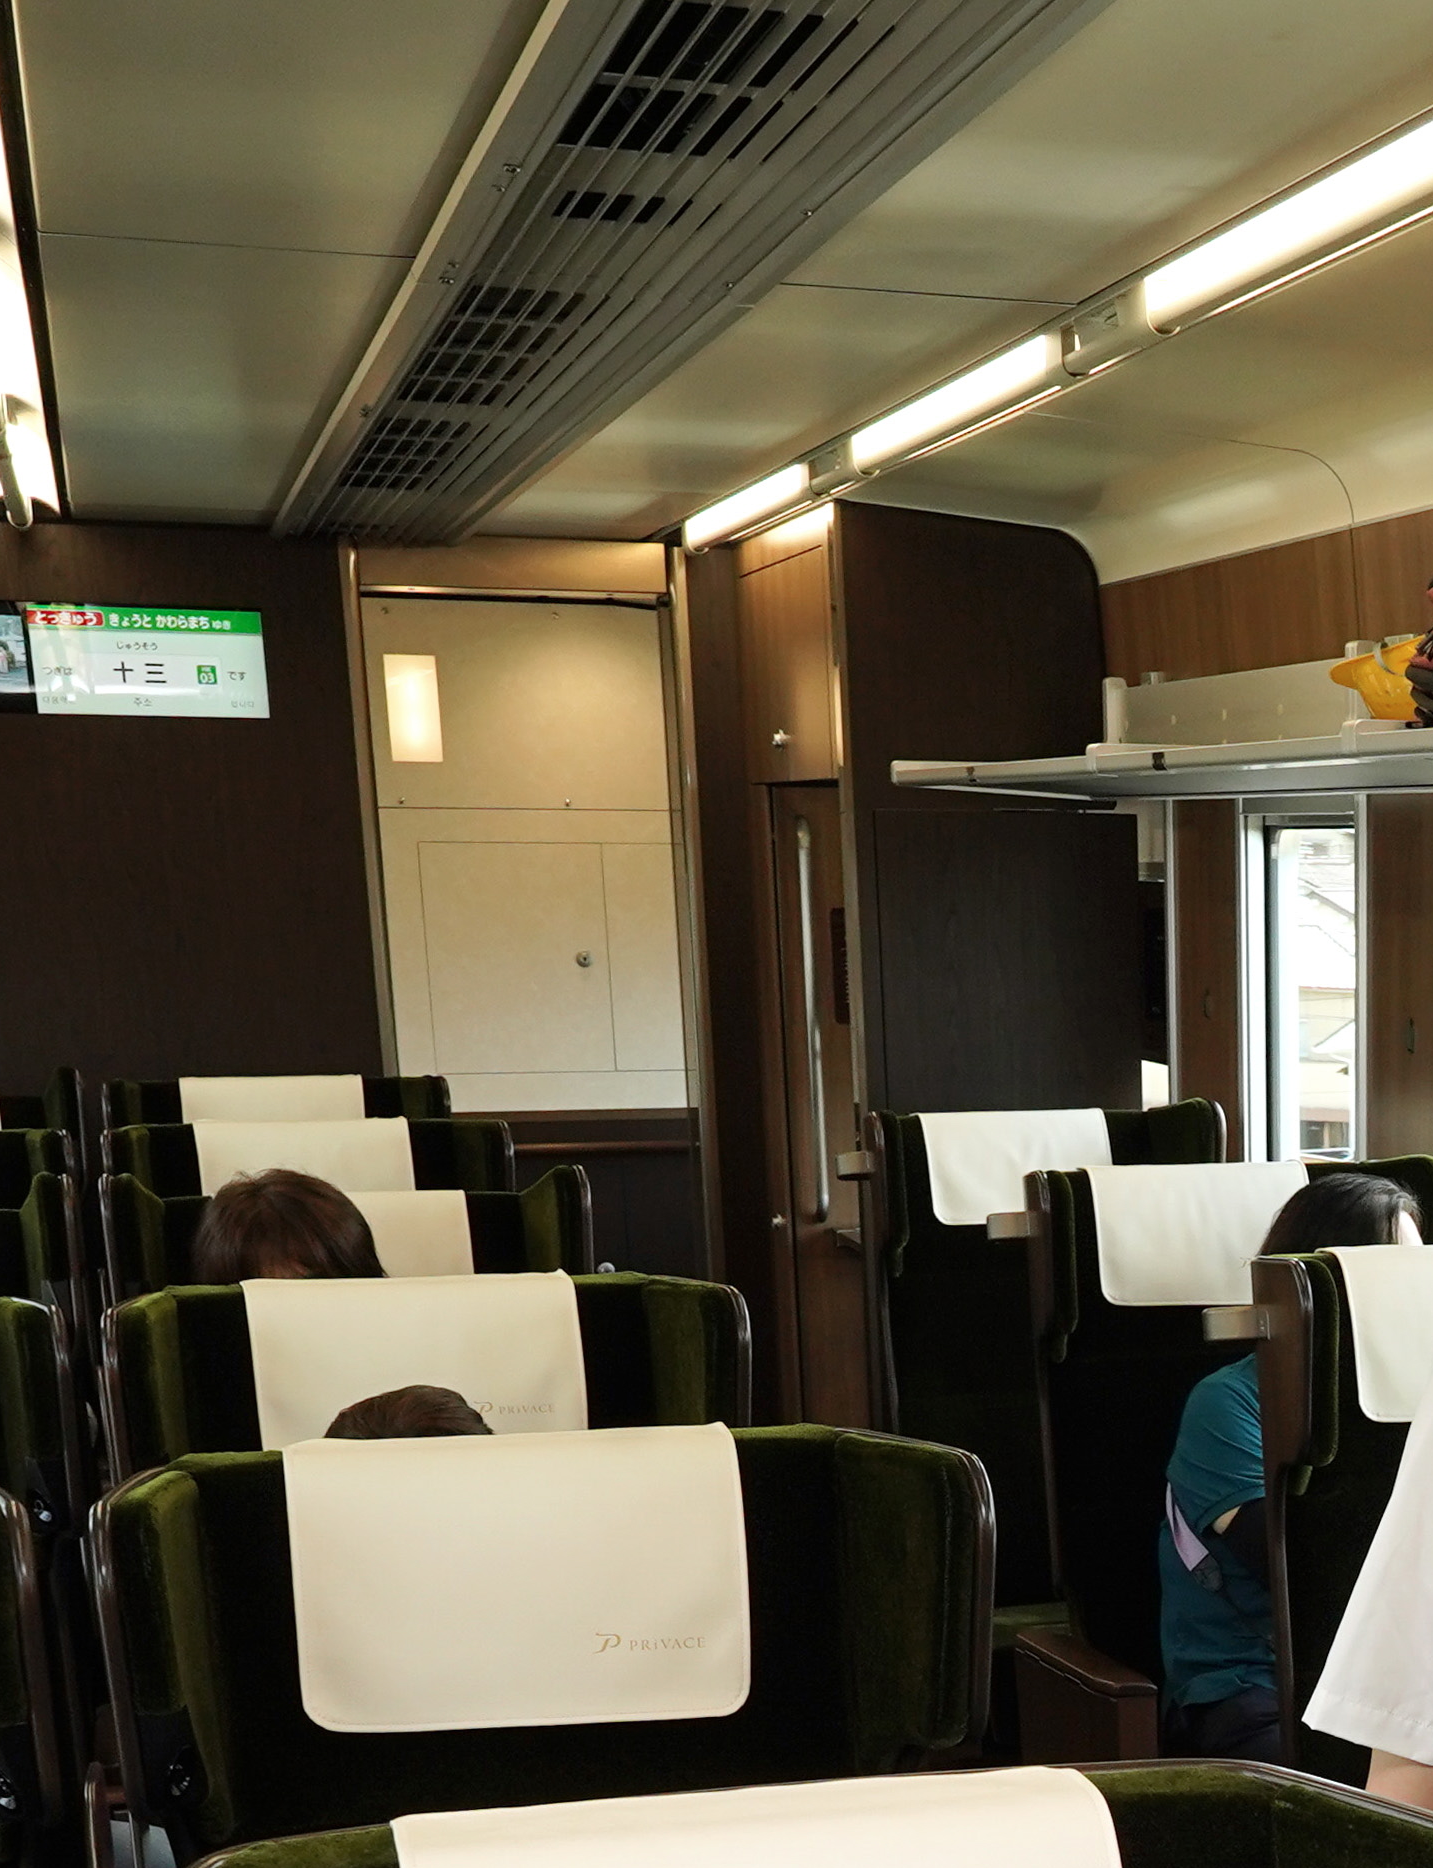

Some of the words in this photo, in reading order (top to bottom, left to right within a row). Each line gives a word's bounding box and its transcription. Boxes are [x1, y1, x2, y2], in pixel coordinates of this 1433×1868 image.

[34, 611, 97, 625] とっきゅう
[116, 641, 158, 651] じゅうそう
[42, 666, 73, 676] つぎは
[112, 661, 167, 684] 十三
[199, 672, 216, 684] 03
[227, 671, 247, 681] です
